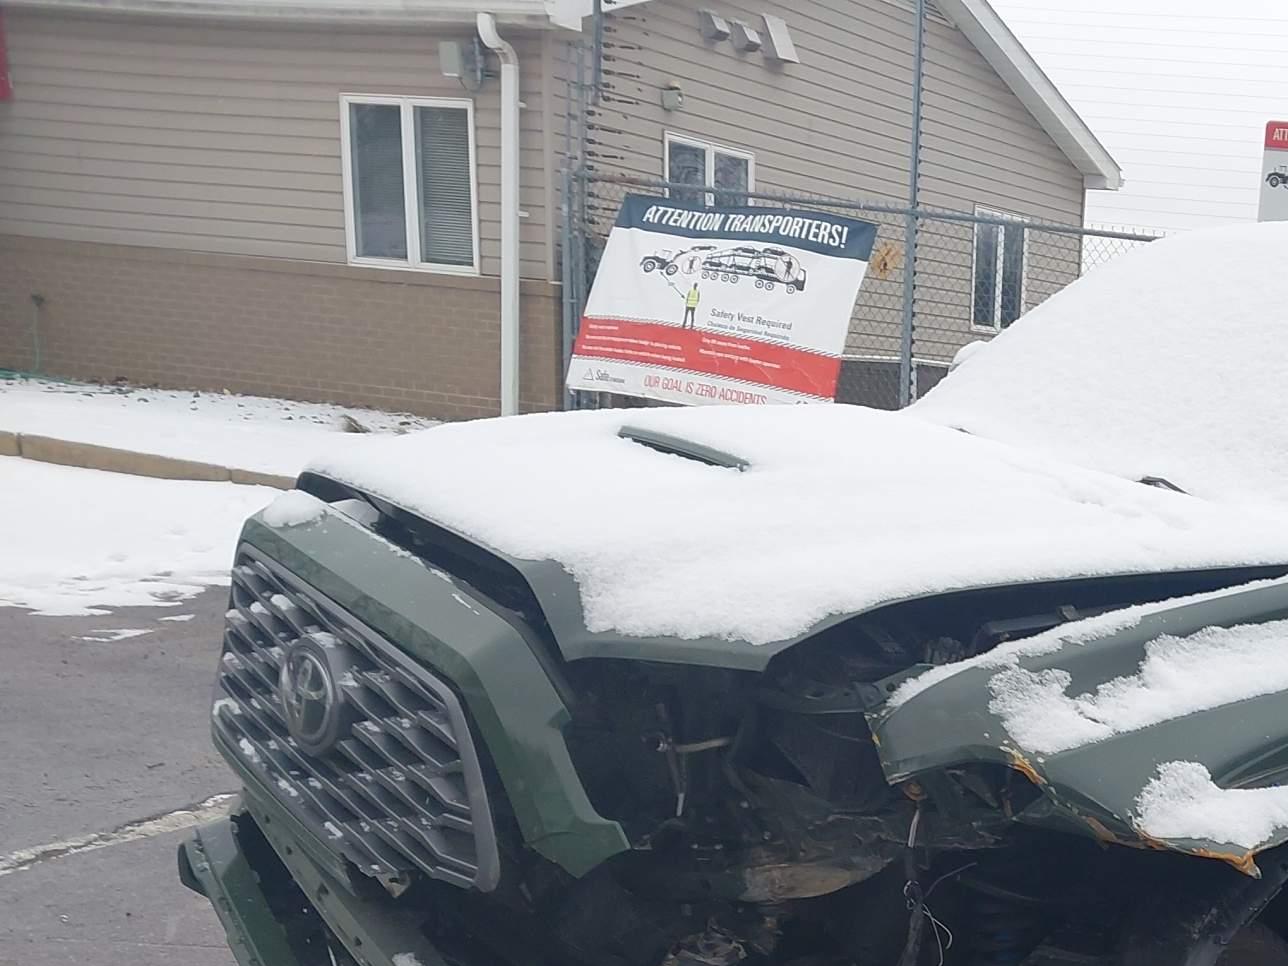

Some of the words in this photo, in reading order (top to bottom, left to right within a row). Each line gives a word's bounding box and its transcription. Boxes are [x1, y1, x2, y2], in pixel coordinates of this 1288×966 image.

[643, 205, 725, 231] ATTENTION
[724, 213, 848, 248] TRANSPORTERS!
[710, 308, 734, 321] Safety
[737, 312, 754, 324] Vest
[755, 316, 793, 330] Required
[643, 375, 660, 387] OUR
[661, 377, 683, 392] GOAL
[685, 381, 694, 393] IS
[695, 383, 717, 399] ZERO
[718, 388, 768, 405] ACCIDENTS
